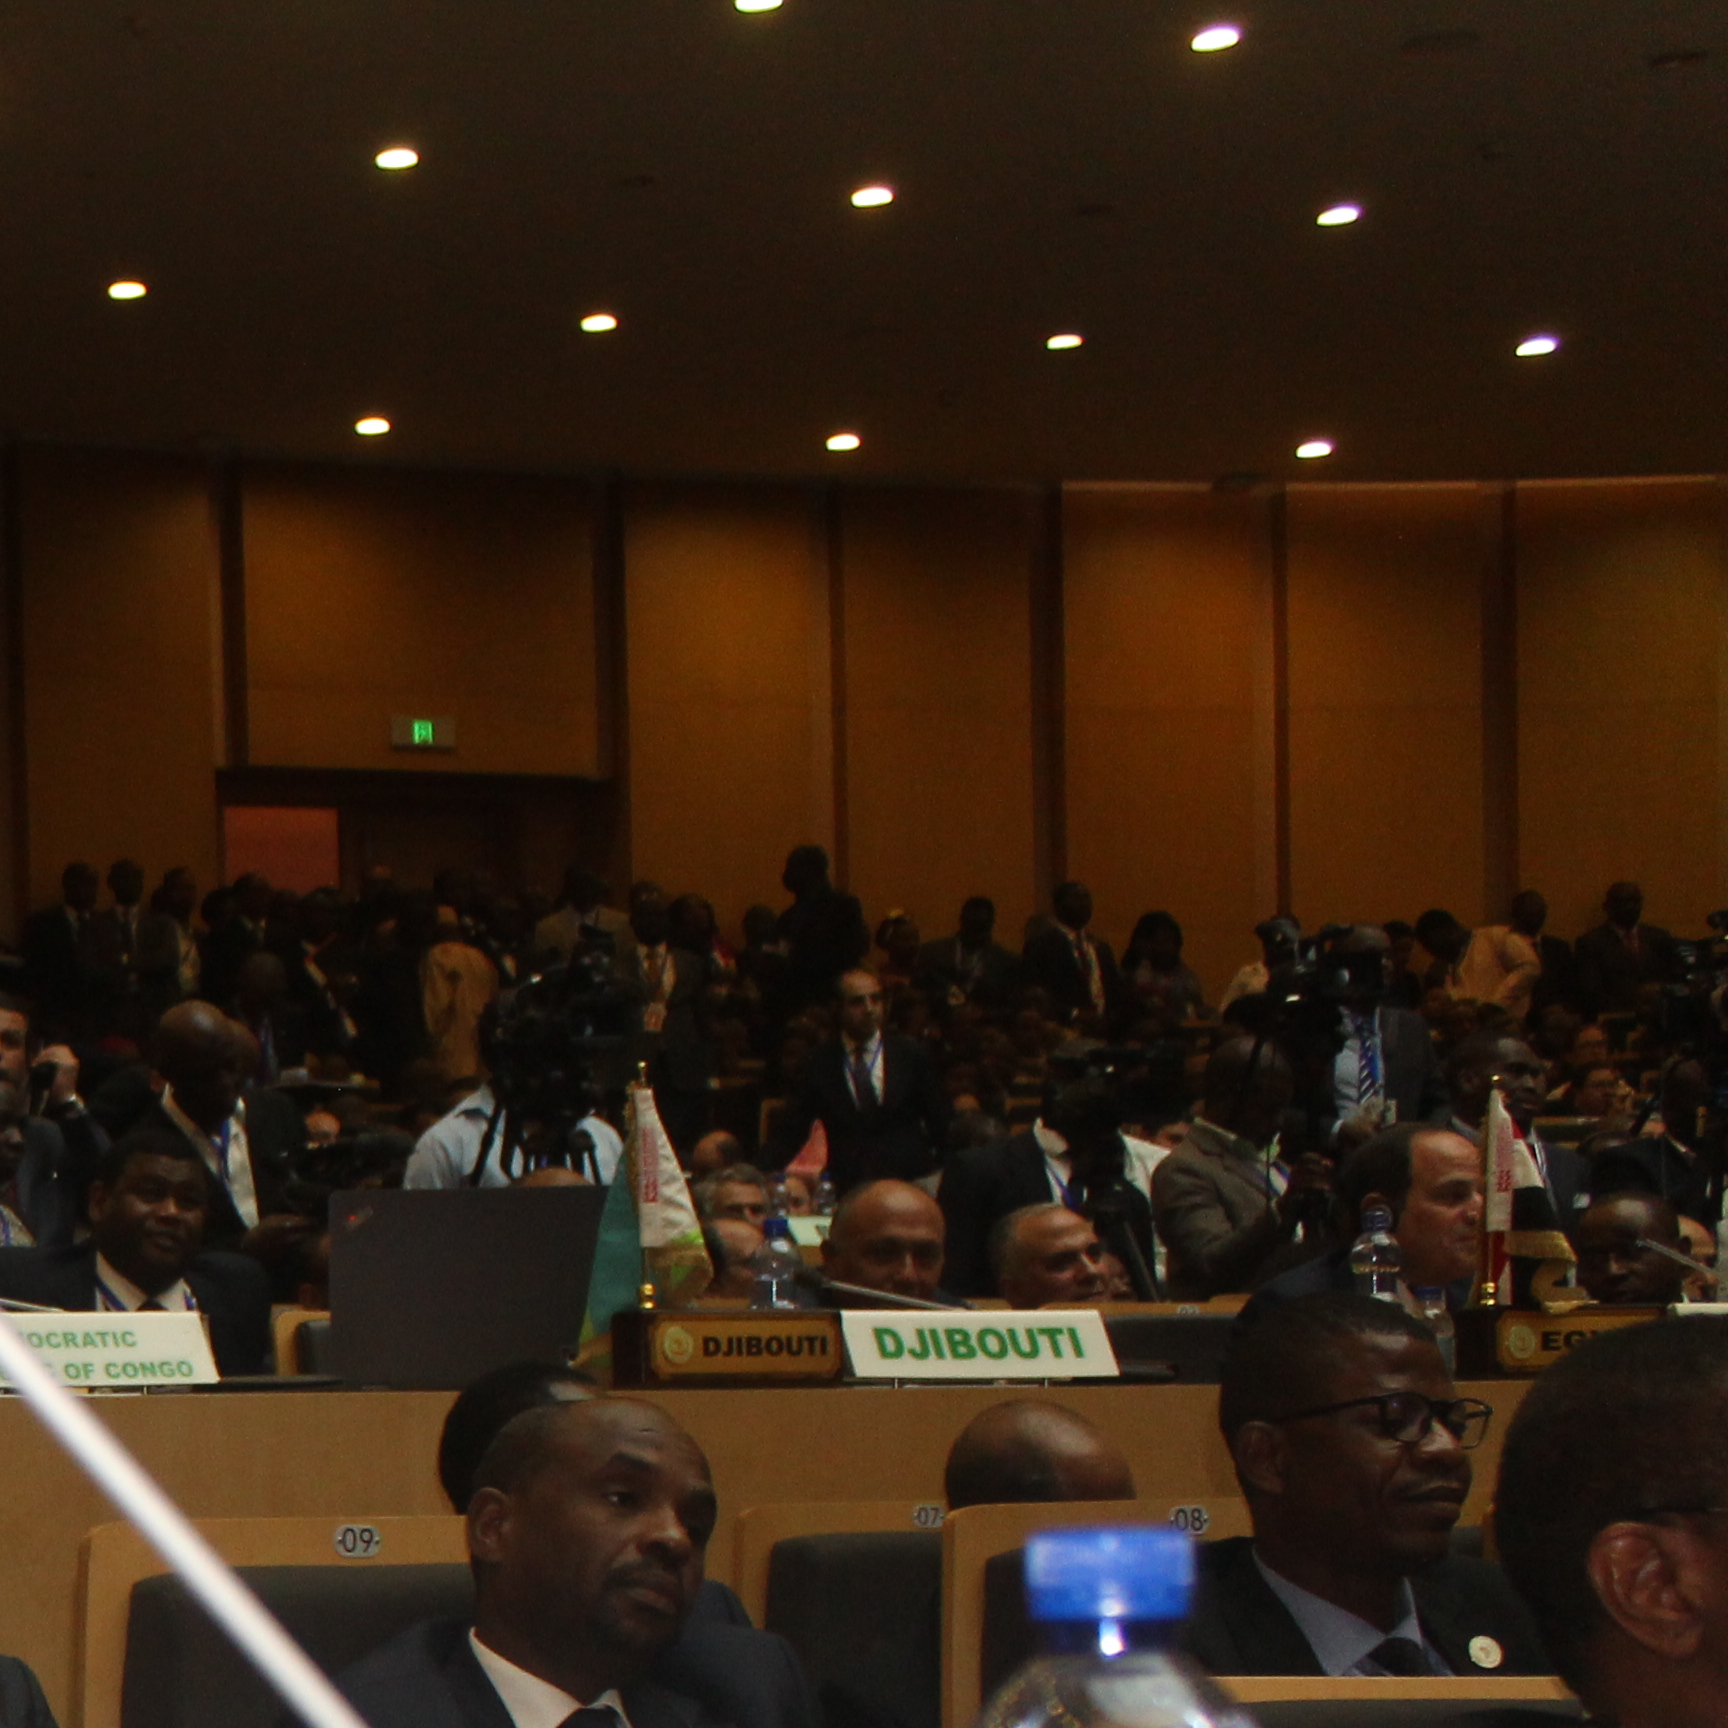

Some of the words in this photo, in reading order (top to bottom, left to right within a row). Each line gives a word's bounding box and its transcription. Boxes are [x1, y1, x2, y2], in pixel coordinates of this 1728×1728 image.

[701, 1335, 829, 1358] DJIBOUTI
[872, 1327, 1086, 1360] DJIBOUTI
[64, 1362, 95, 1380] OF
[105, 1360, 195, 1379] CONGO
[916, 1506, 940, 1526] 07
[1174, 1507, 1204, 1532] 08
[342, 1527, 374, 1554] 09
